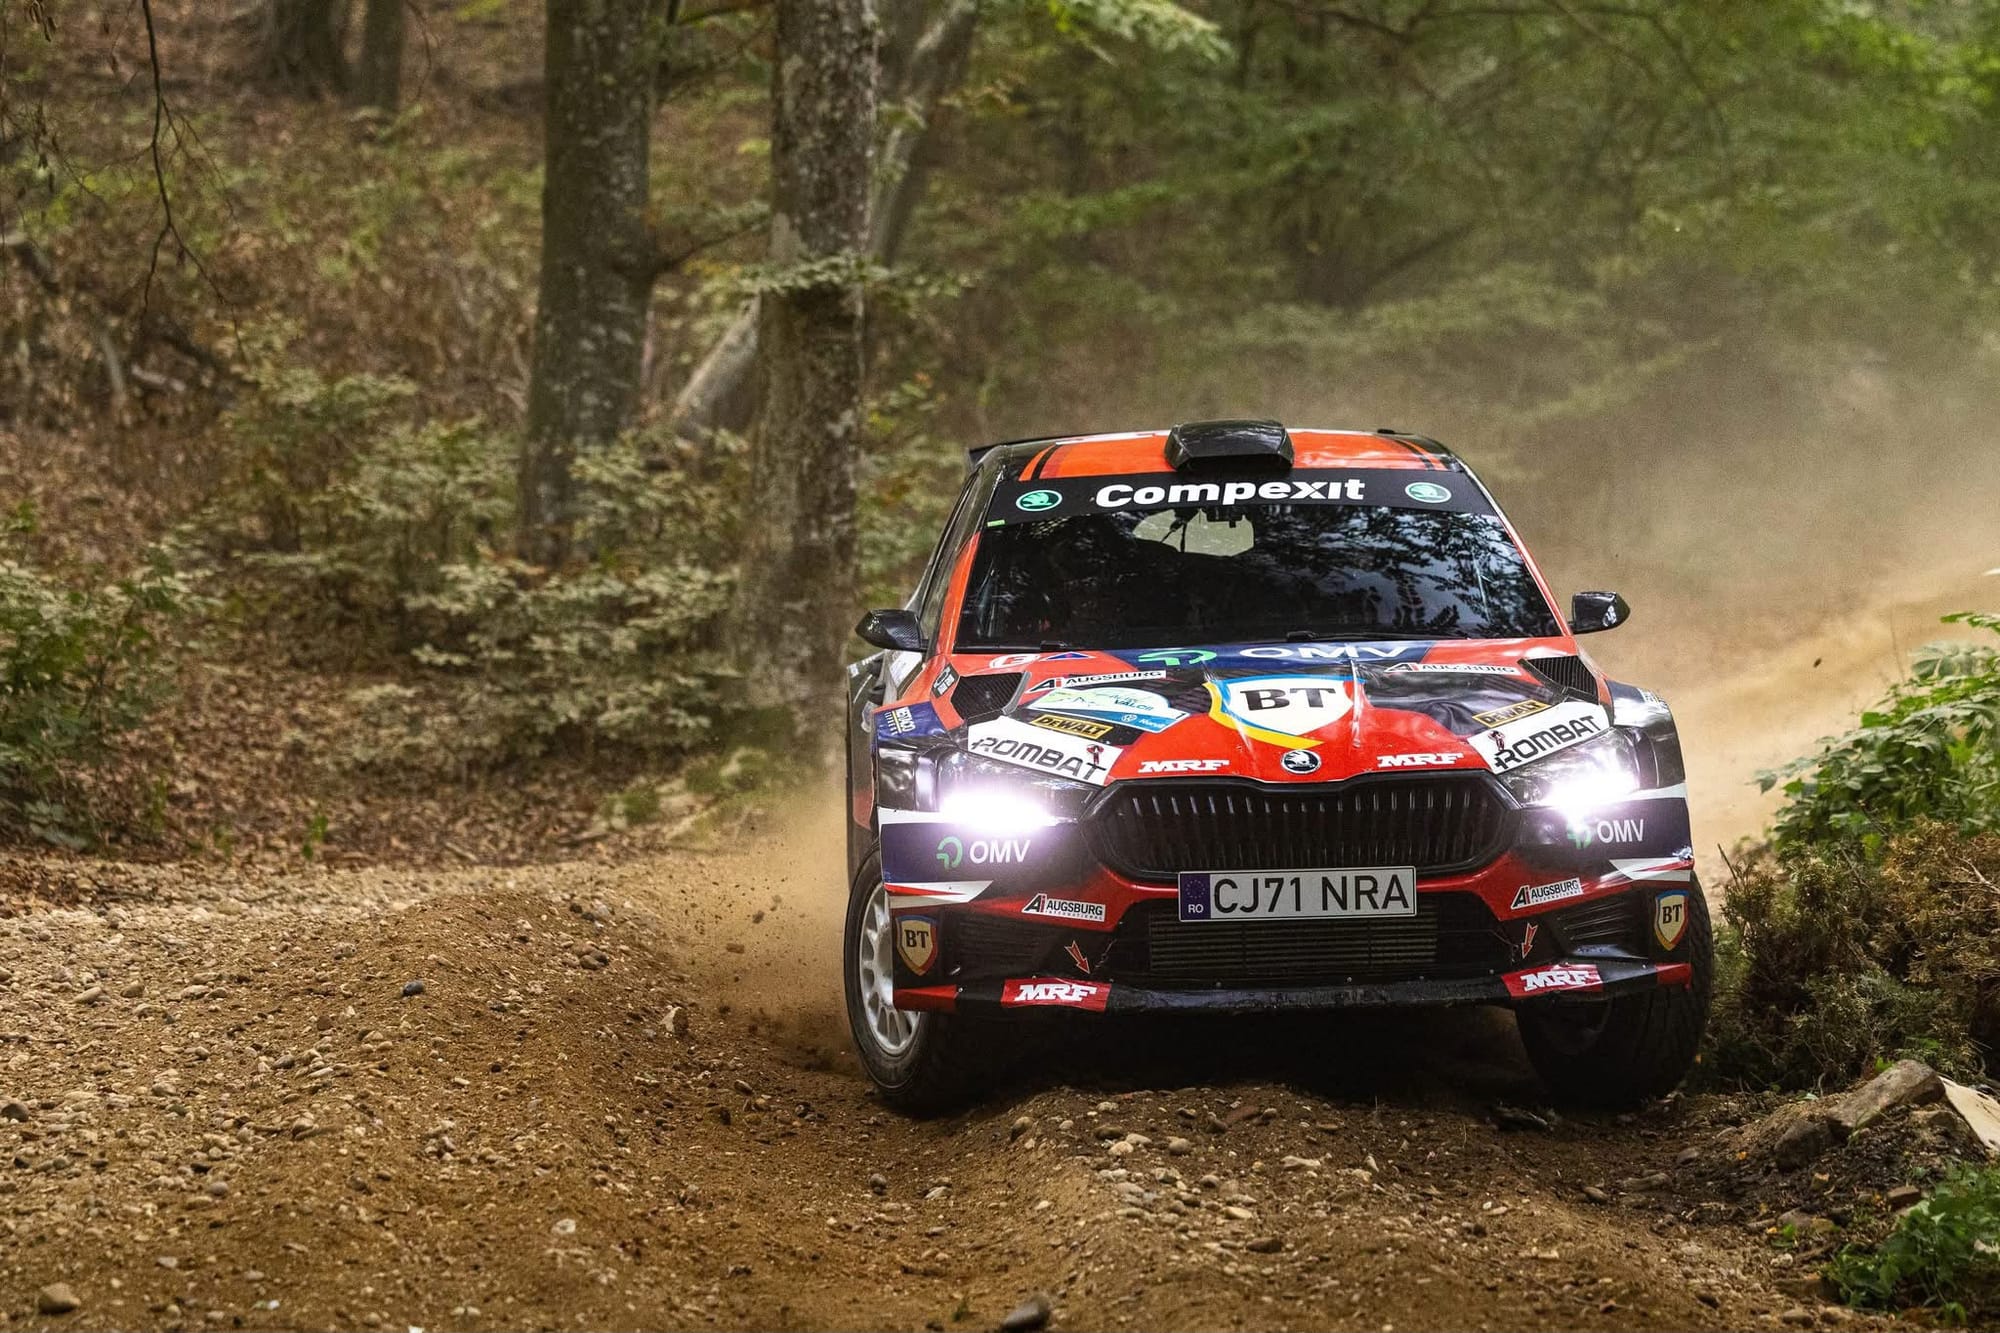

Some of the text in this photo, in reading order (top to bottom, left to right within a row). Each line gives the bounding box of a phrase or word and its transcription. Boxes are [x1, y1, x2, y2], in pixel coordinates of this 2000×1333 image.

[1096, 478, 1365, 507] Compexit
[1240, 646, 1410, 659] OMV
[1065, 671, 1161, 684] AUGSBURG
[1240, 687, 1336, 711] BT
[1039, 717, 1106, 736] DEWALT
[1494, 715, 1602, 770] ROMBAT
[971, 736, 1107, 781] ROMBAT
[1138, 759, 1230, 773] MRF
[1376, 753, 1464, 768] MRF
[1597, 818, 1645, 844] OMV
[969, 839, 1031, 864] OMV
[1213, 874, 1410, 913] CJ71 NRA
[1531, 879, 1578, 900] AUGSBURG
[1046, 900, 1103, 916] AUGSBURG
[1188, 903, 1204, 914] RO
[1662, 904, 1683, 925] BT
[904, 929, 929, 949] BT
[1520, 969, 1602, 992] MRF
[1014, 983, 1097, 1003] MRF
